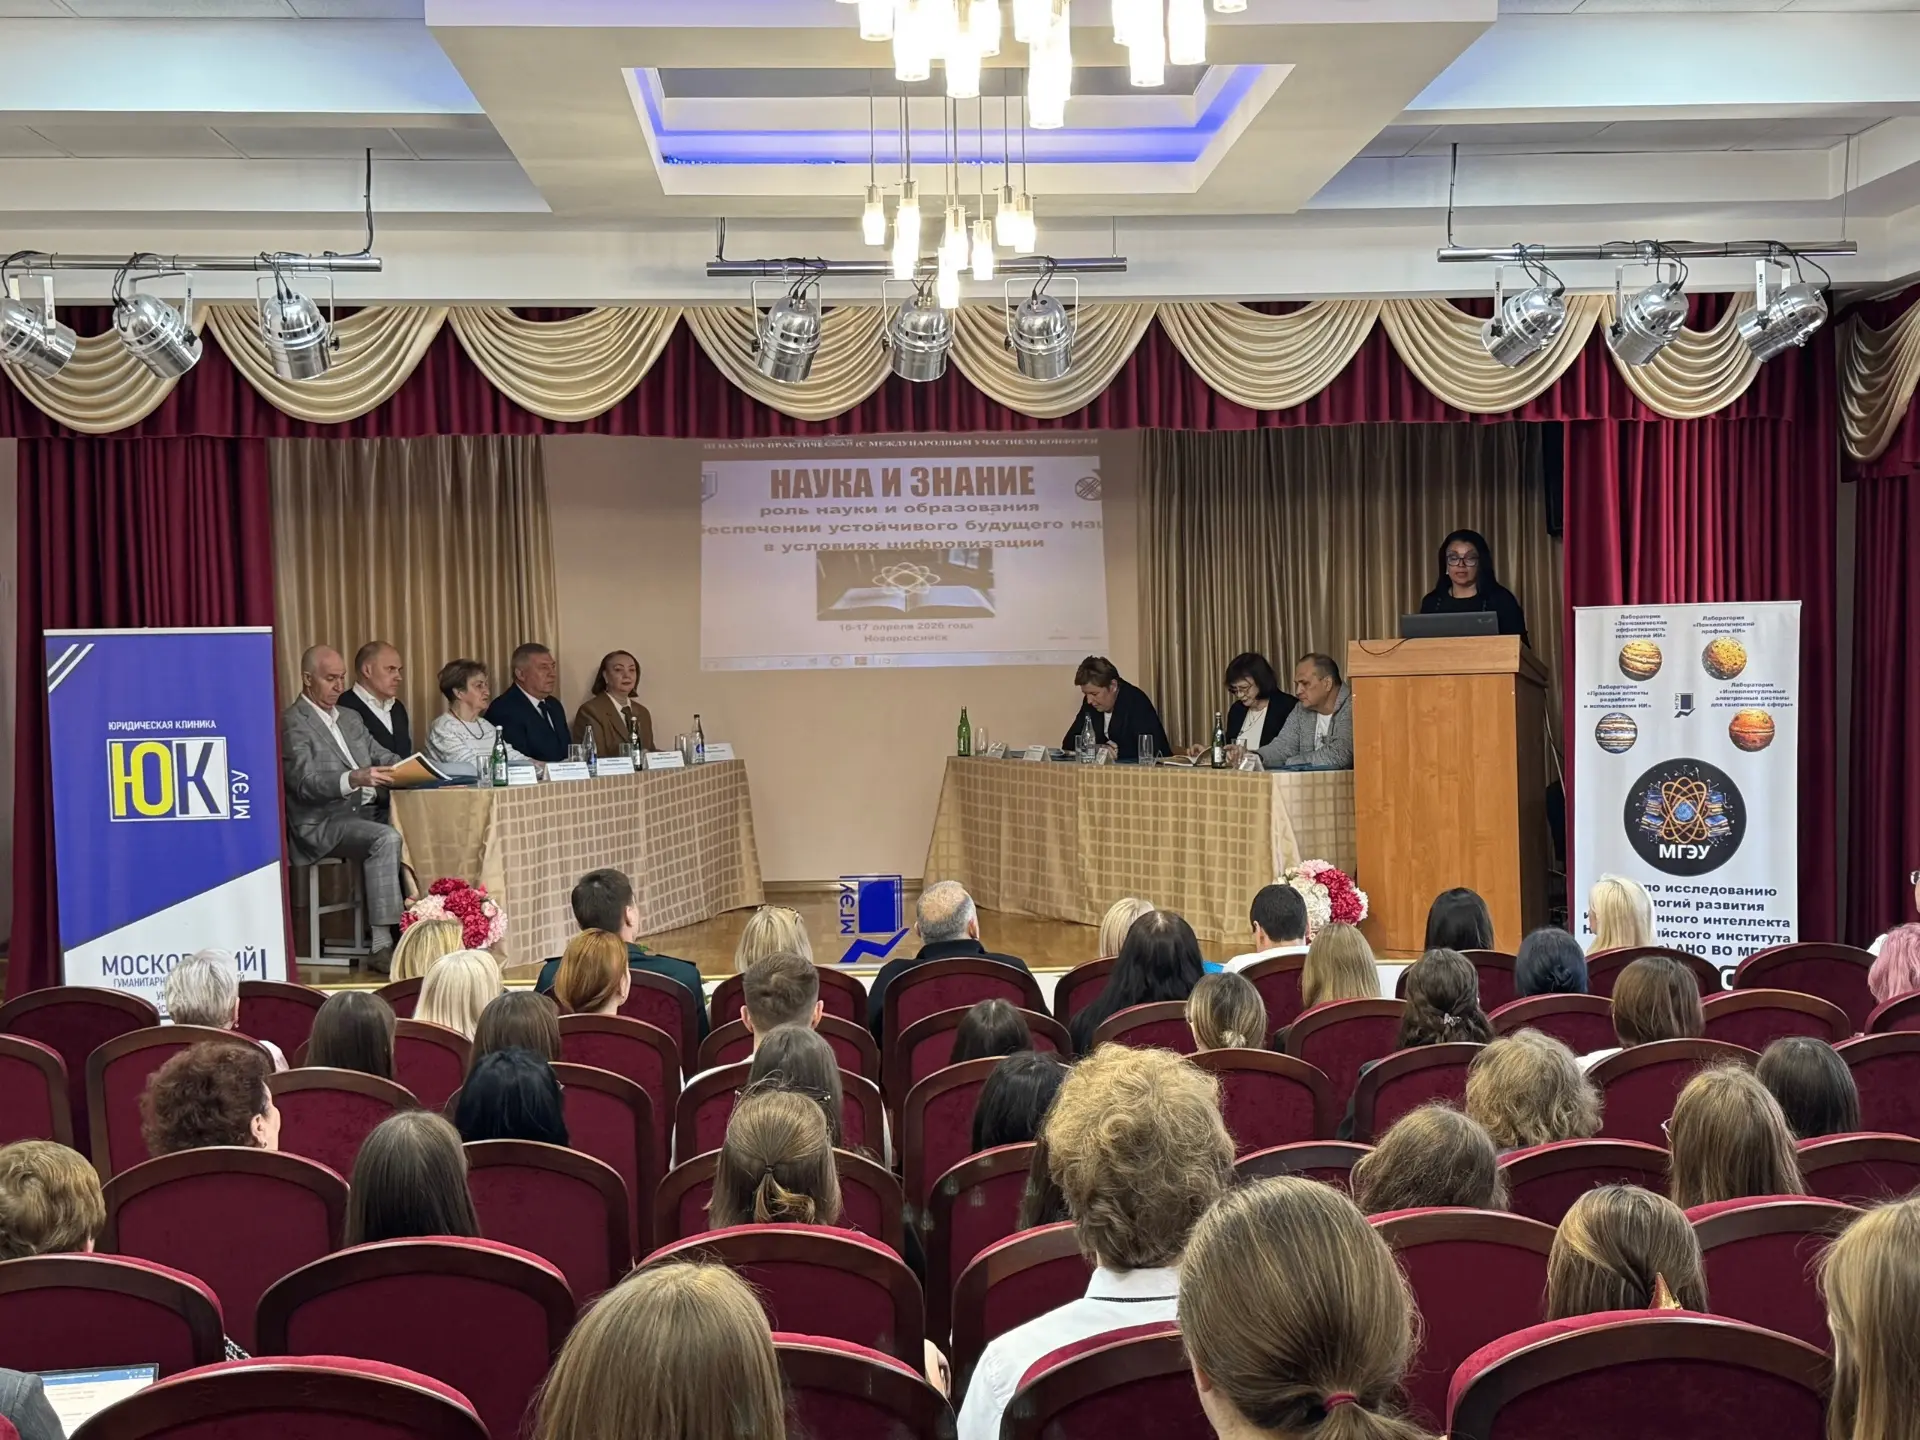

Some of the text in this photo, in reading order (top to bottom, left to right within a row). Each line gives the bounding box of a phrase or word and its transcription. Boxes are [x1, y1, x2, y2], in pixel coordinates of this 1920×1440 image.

[869, 439, 972, 447] МЕЖДУНАРОДНЫМ
[770, 465, 1036, 499] НАУКА И ЗНАНИЕ
[760, 502, 1040, 518] роль науки и образования
[828, 521, 958, 535] устойчивого
[965, 519, 1064, 532] будущего
[764, 537, 1045, 554] в условиях цифровизации
[107, 719, 217, 732] ЮРИДИЧЕСКАЯ КЛИНИКА
[110, 741, 222, 817] ЮК
[230, 769, 251, 820] МГЭУ
[1658, 843, 1712, 860] МГЭУ
[1665, 884, 1778, 897] исследованию
[839, 882, 856, 935] МГЭУ
[1653, 898, 1765, 912] огий развития
[1703, 916, 1791, 928] интеллекта
[1716, 931, 1791, 945] института
[1711, 945, 1733, 956] ВО
[1737, 946, 1764, 957] МГ
